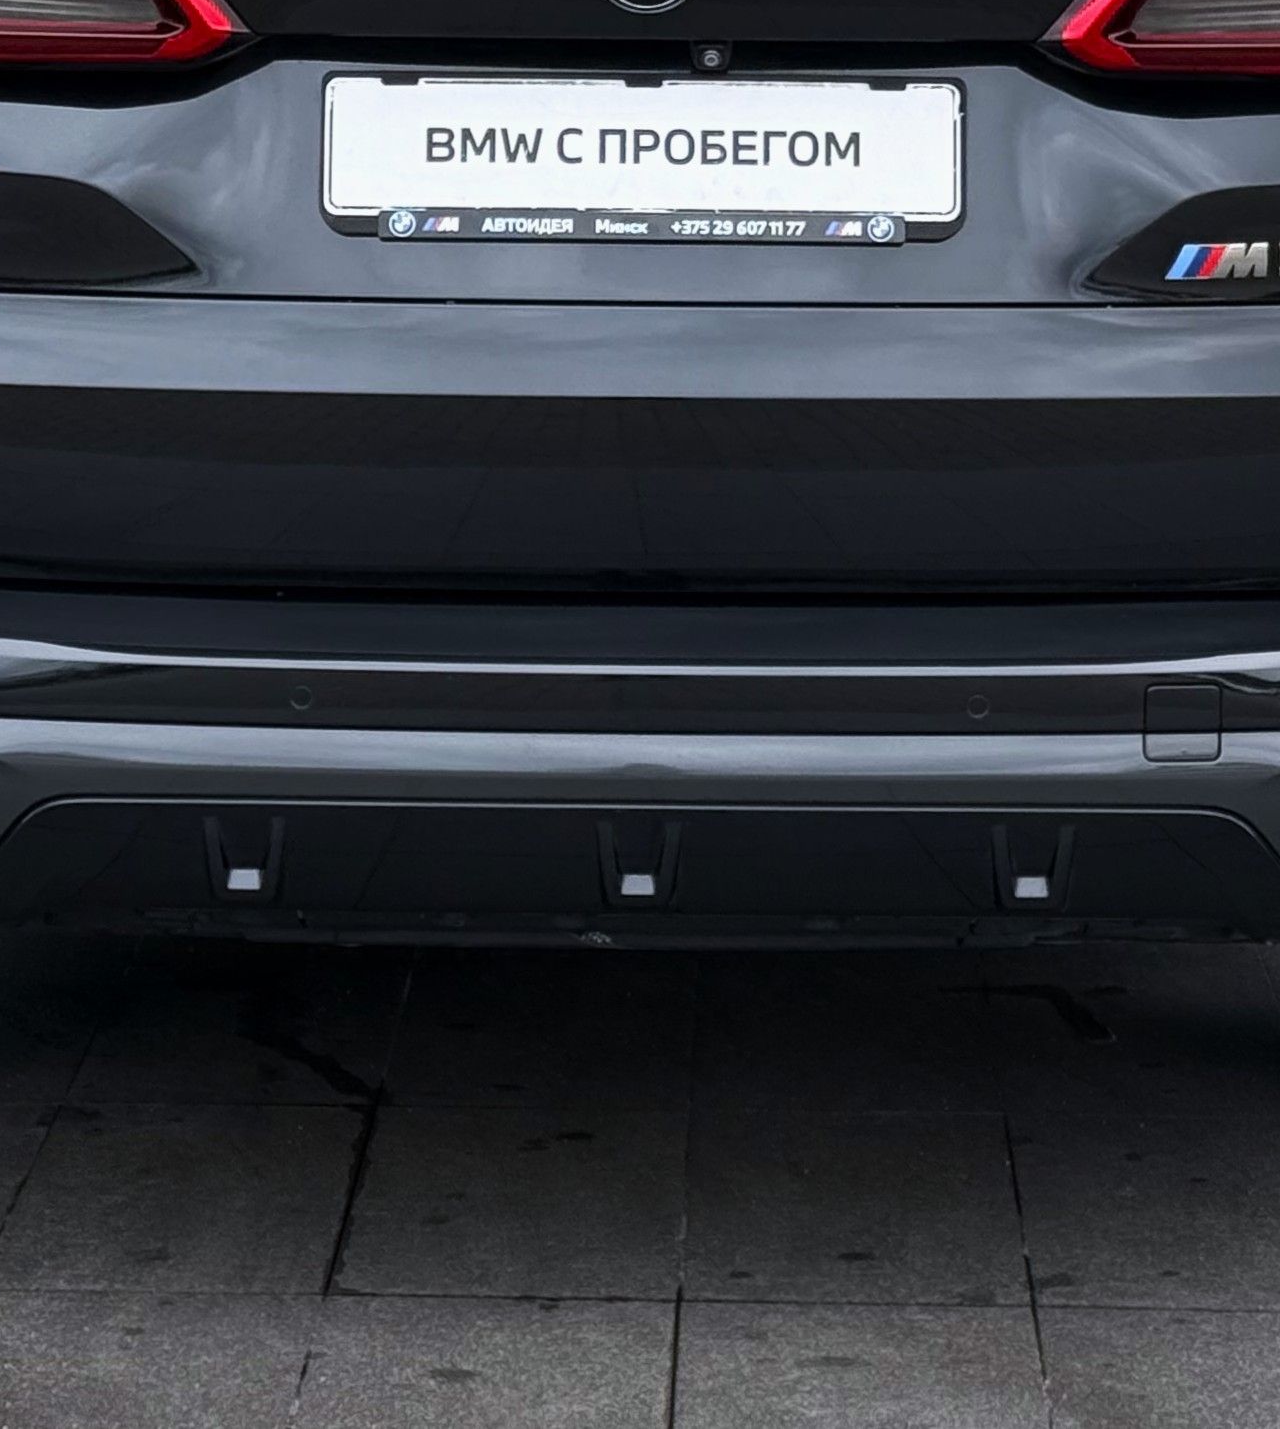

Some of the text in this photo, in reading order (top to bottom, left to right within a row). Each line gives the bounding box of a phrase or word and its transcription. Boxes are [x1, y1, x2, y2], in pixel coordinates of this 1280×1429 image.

[426, 127, 861, 167] BMW С ПРОБЕГОМ
[481, 217, 574, 235] АВТОИДЕЯ
[595, 218, 649, 235] Минск
[670, 219, 711, 235] +375
[712, 220, 734, 236] 29
[736, 220, 768, 236] 607
[768, 220, 784, 236] 11
[785, 221, 807, 237] 77
